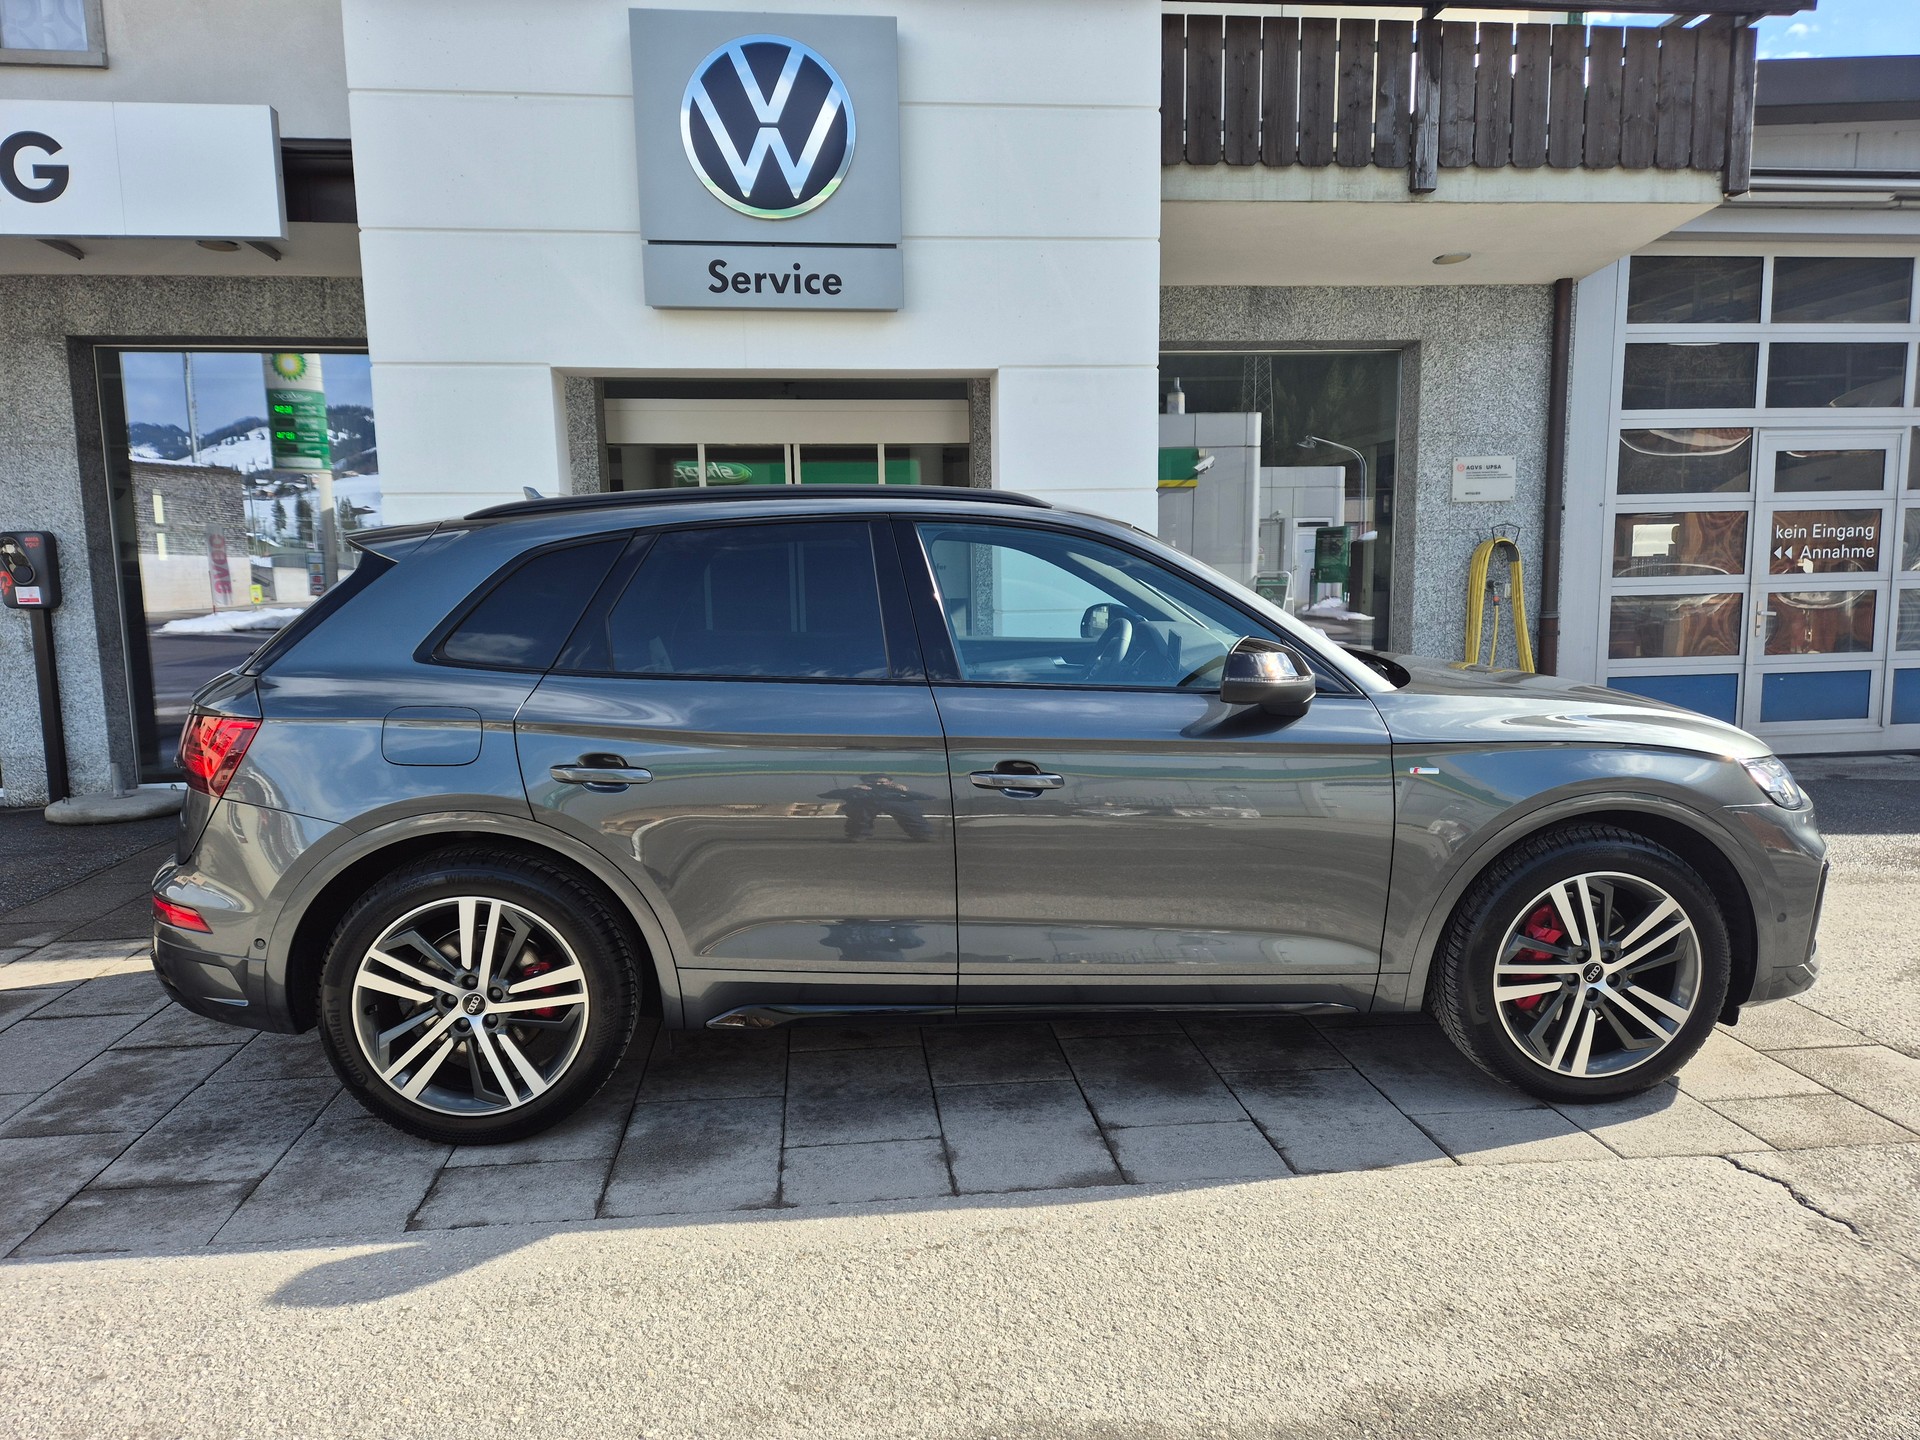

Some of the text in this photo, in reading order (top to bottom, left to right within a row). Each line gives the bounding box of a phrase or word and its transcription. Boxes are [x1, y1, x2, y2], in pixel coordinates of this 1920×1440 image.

[708, 259, 843, 295] Service
[1775, 523, 1875, 541] kein Eingang
[1800, 544, 1875, 559] Annahme
